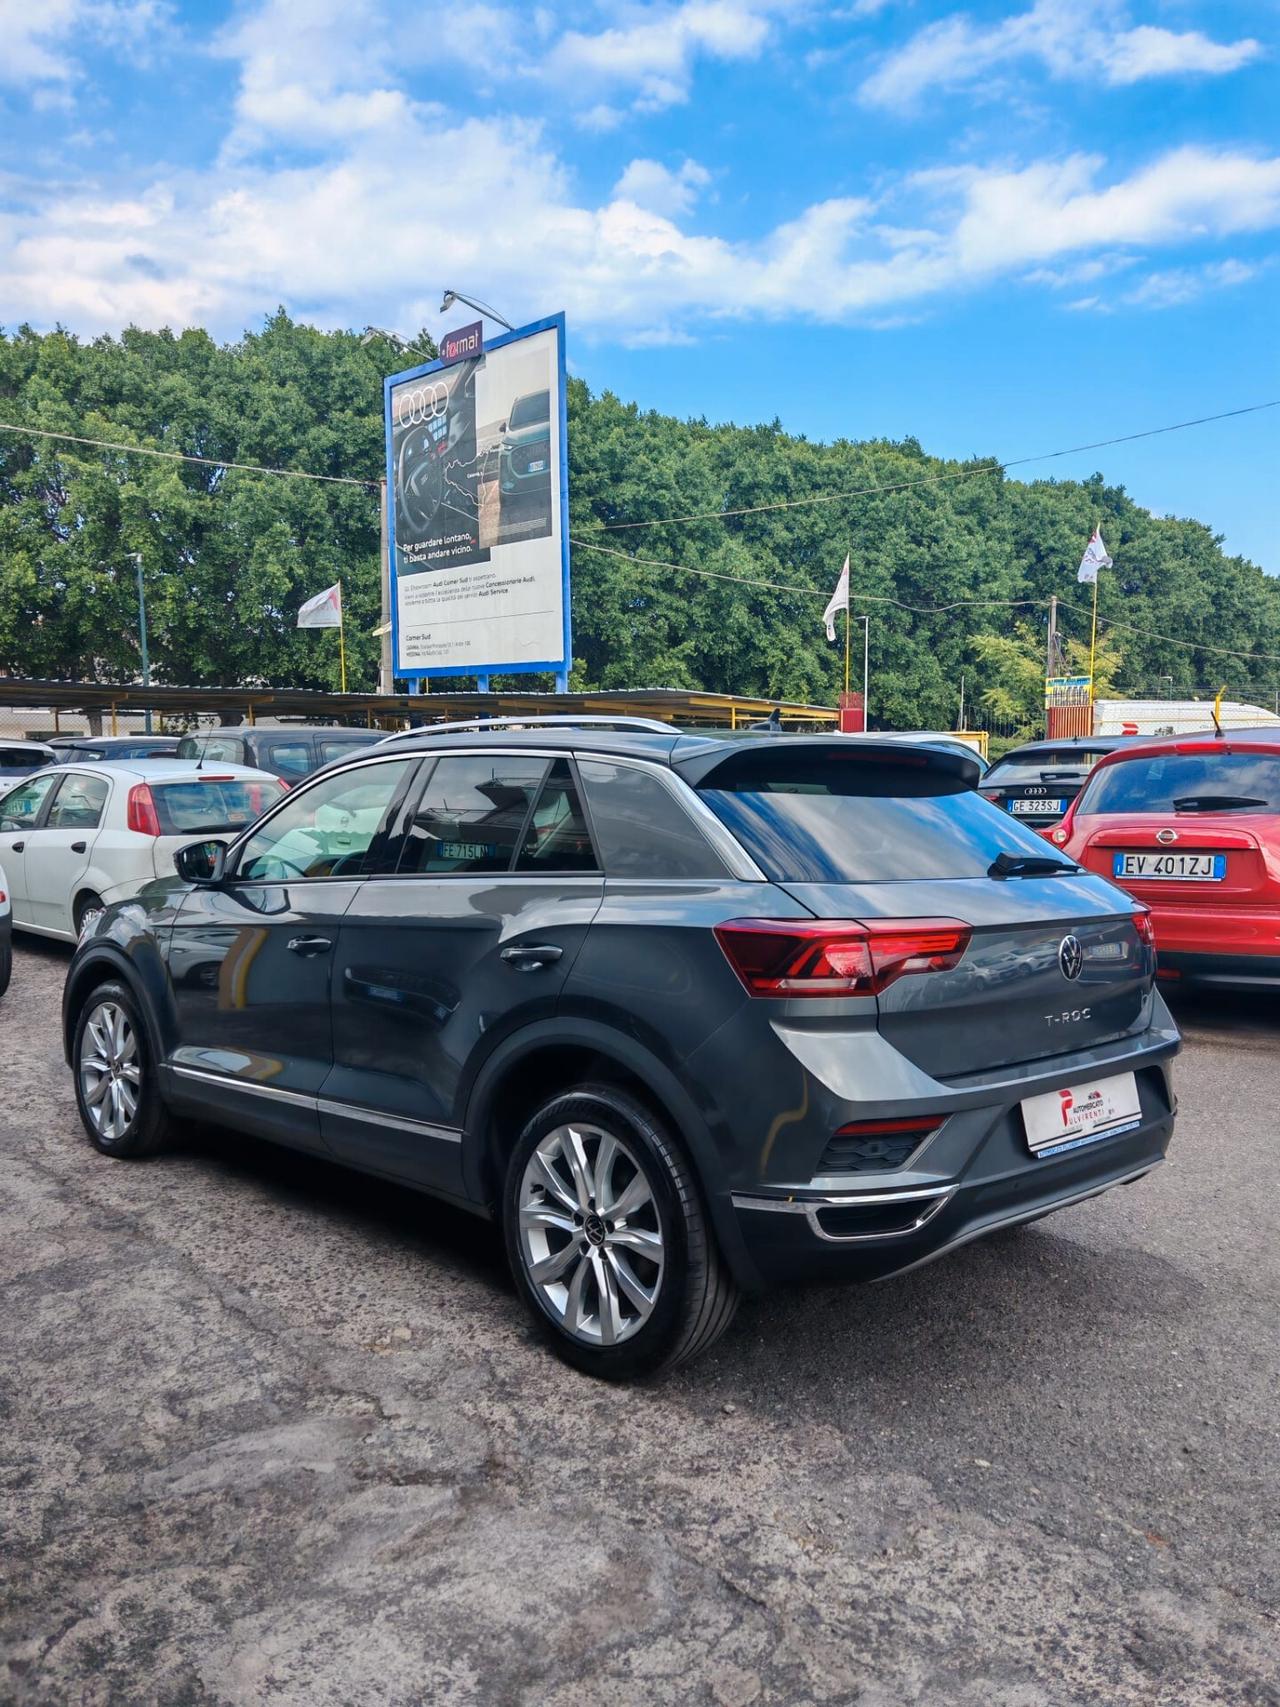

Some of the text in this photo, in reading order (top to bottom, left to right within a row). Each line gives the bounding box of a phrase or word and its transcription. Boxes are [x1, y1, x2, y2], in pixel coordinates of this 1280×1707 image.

[446, 330, 479, 358] format
[403, 543, 414, 552] Per
[414, 538, 443, 552] guardare
[409, 553, 427, 563] basta
[427, 549, 450, 559] andare
[451, 545, 473, 555] vicino.
[1013, 801, 1059, 811] GE 323SJ
[1125, 856, 1212, 875] EV 401ZJ
[1044, 1008, 1092, 1027] T-ROC
